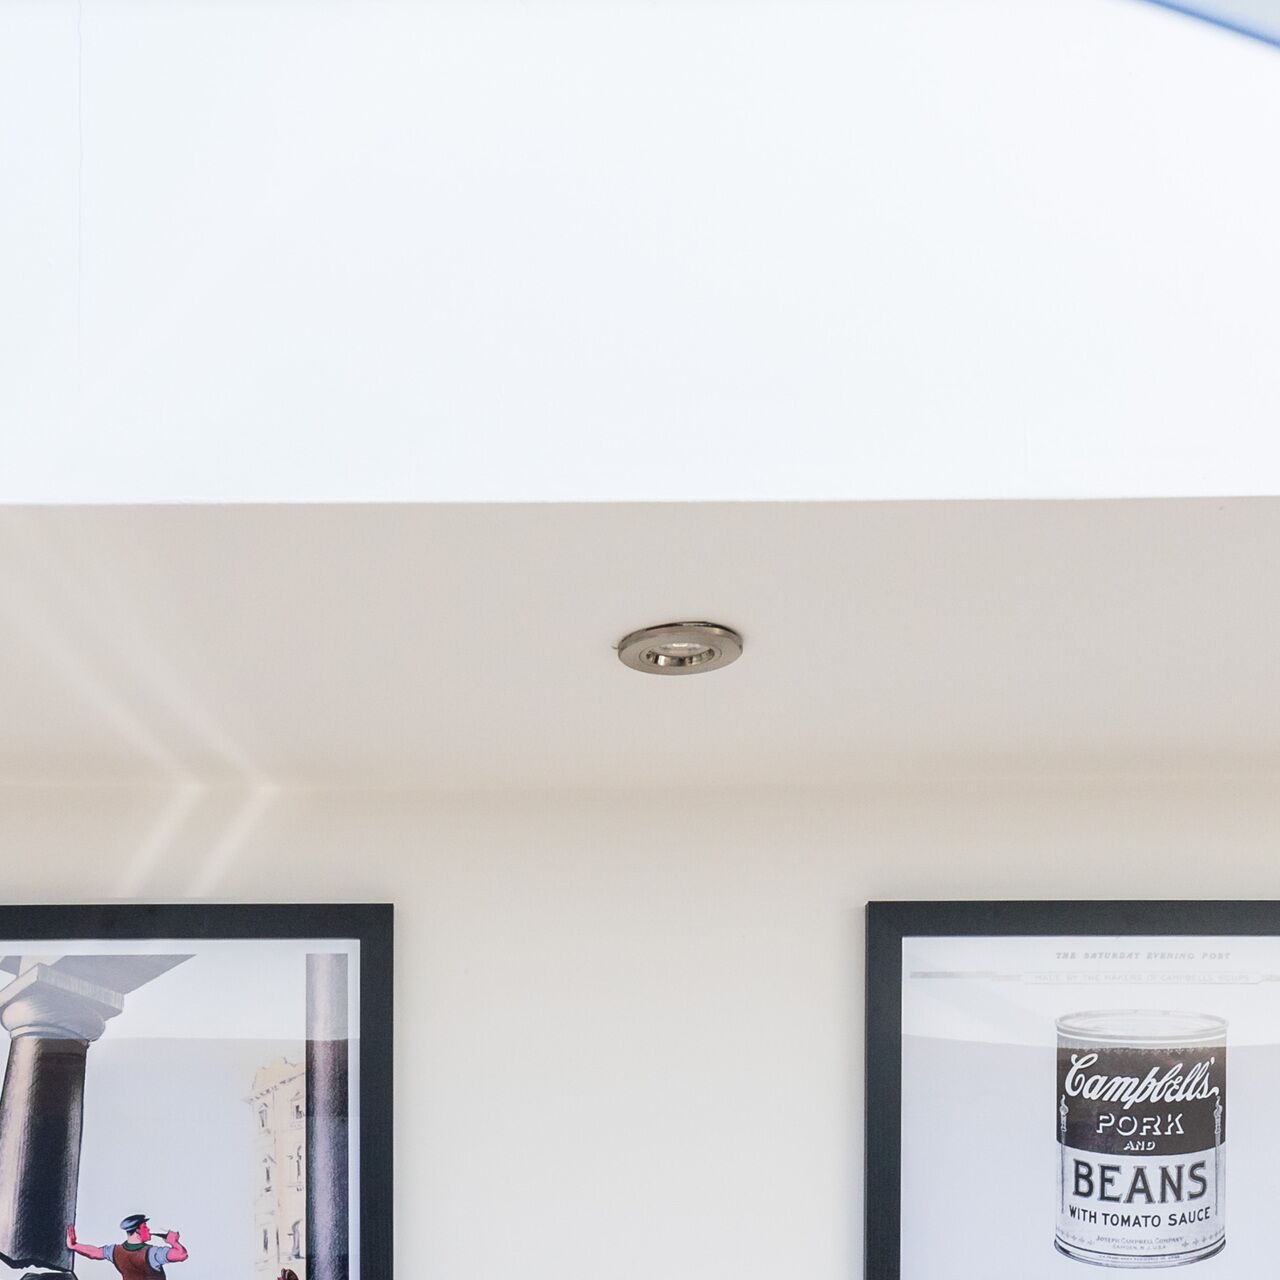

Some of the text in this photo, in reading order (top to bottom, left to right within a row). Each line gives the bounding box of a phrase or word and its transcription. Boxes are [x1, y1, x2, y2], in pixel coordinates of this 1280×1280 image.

[1096, 1112, 1185, 1136] PORK
[1123, 1139, 1156, 1151] AND
[1072, 1159, 1208, 1205] BEANS
[1068, 1205, 1211, 1228] WITH TOMATO SAUCE
